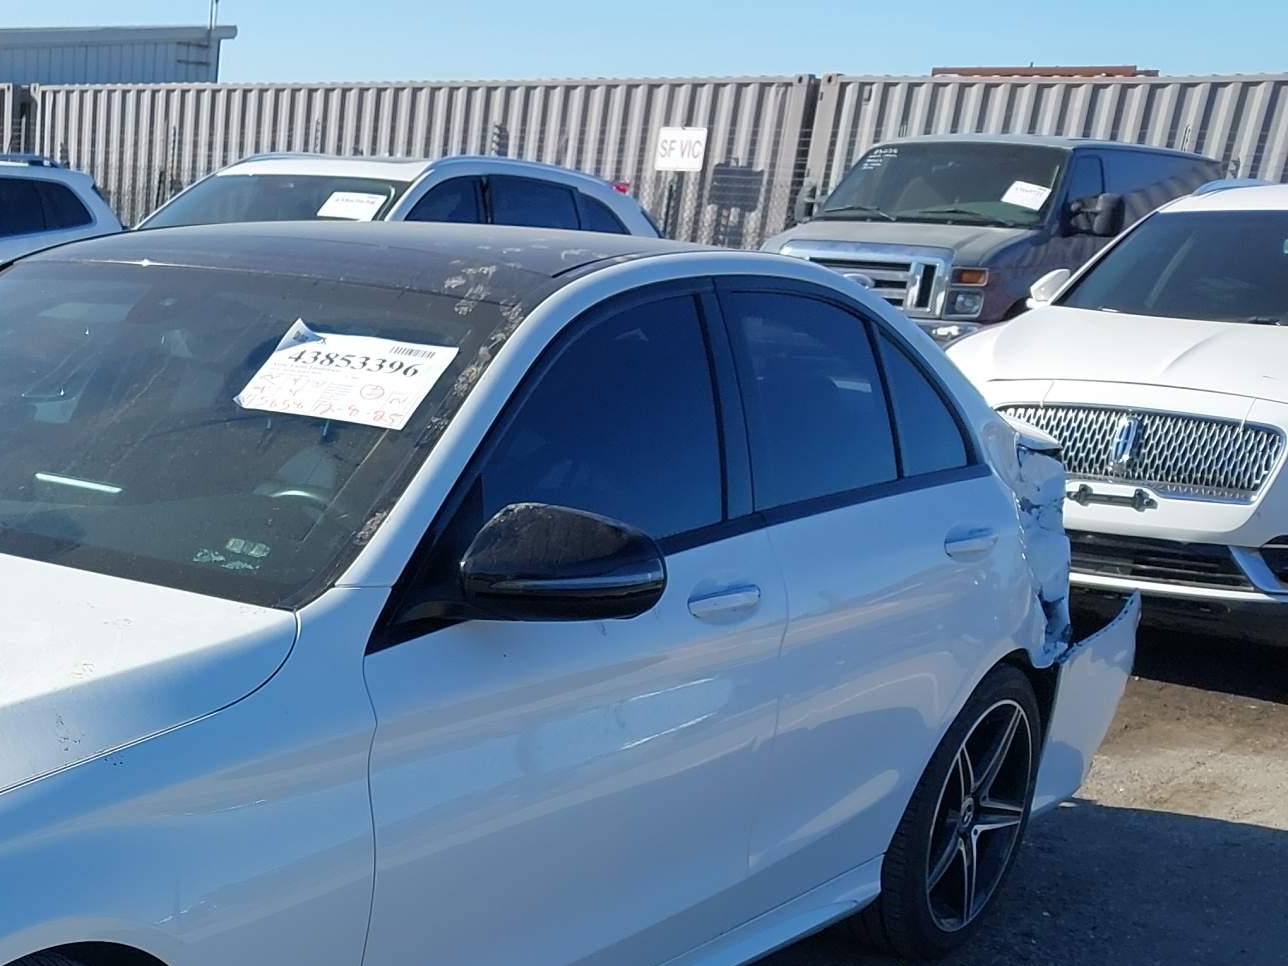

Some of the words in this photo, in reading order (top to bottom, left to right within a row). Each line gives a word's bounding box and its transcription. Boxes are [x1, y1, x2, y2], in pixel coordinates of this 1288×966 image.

[659, 140, 677, 158] SF
[680, 140, 703, 158] VIC
[288, 348, 420, 378] 43853396
